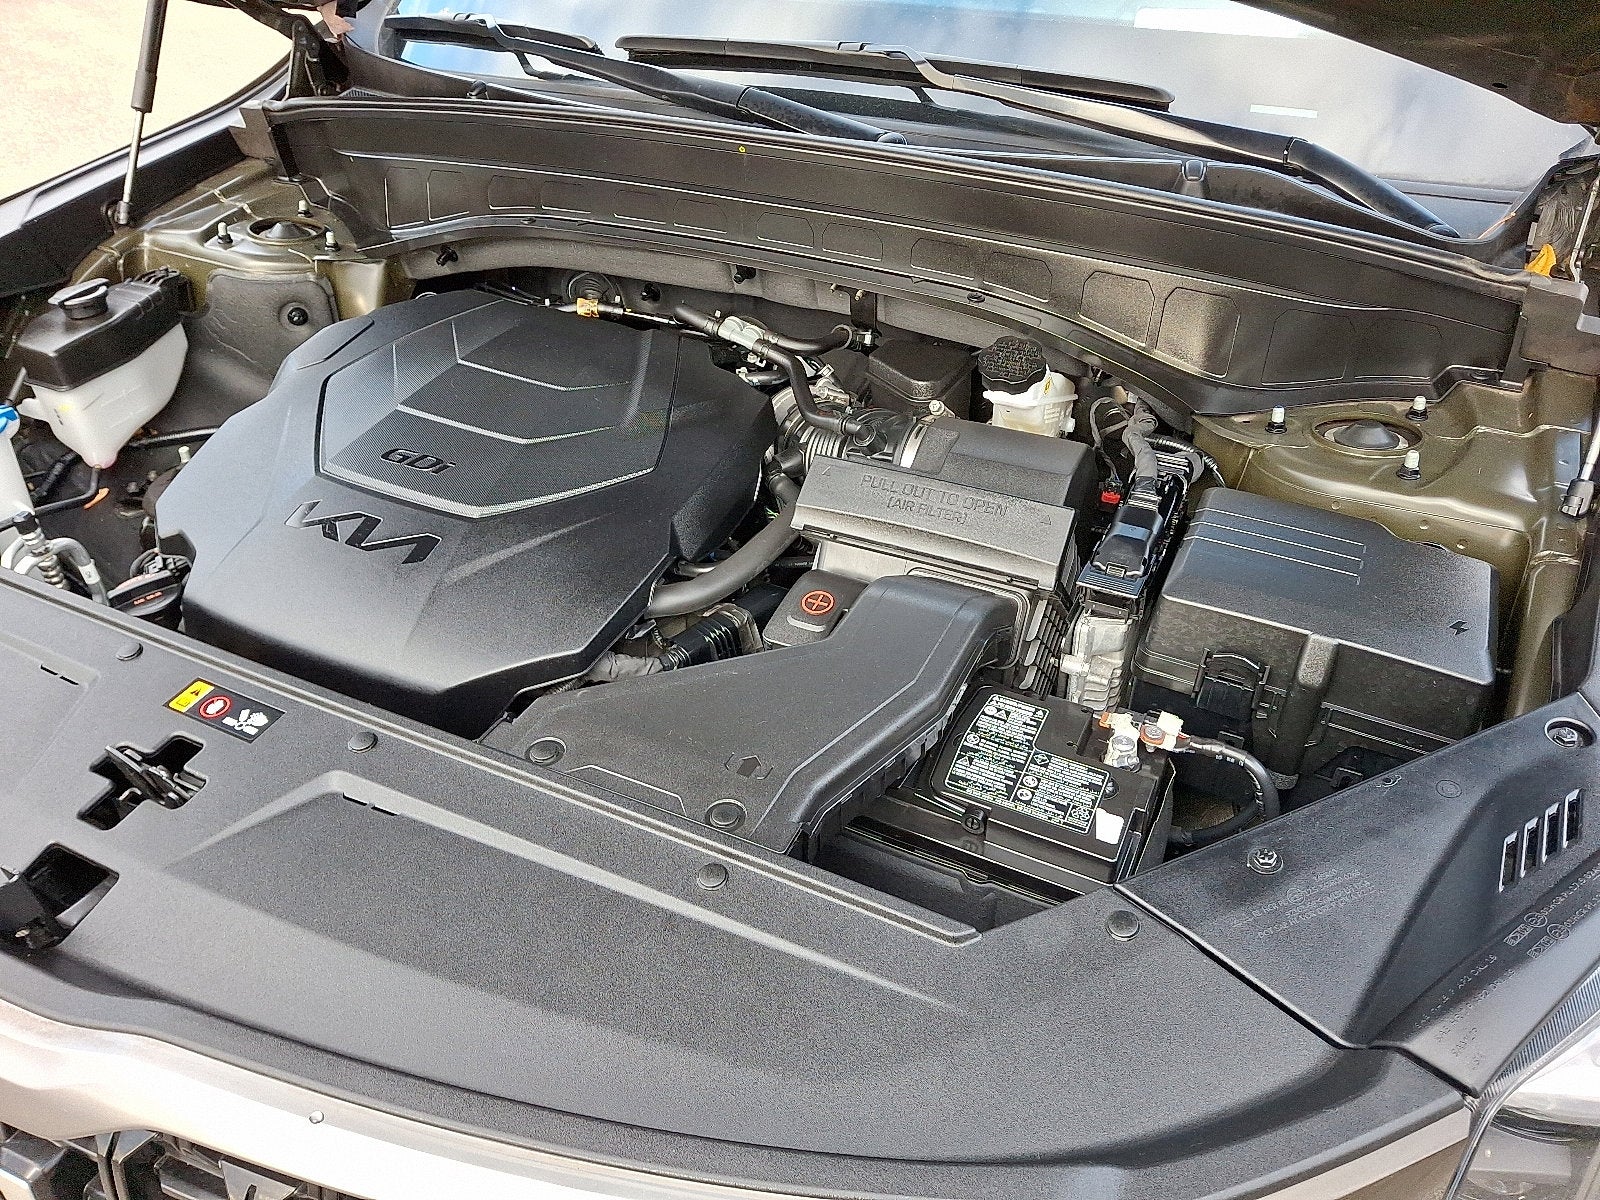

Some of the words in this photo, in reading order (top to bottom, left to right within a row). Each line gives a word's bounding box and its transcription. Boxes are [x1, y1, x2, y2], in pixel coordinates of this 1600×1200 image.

[861, 474, 896, 495] PULL
[903, 483, 933, 500] OUT
[938, 491, 960, 506] TO
[964, 496, 1008, 518] OPEN
[886, 497, 915, 513] (AIR
[918, 503, 968, 526] FILTER)
[284, 499, 443, 565] KIA
